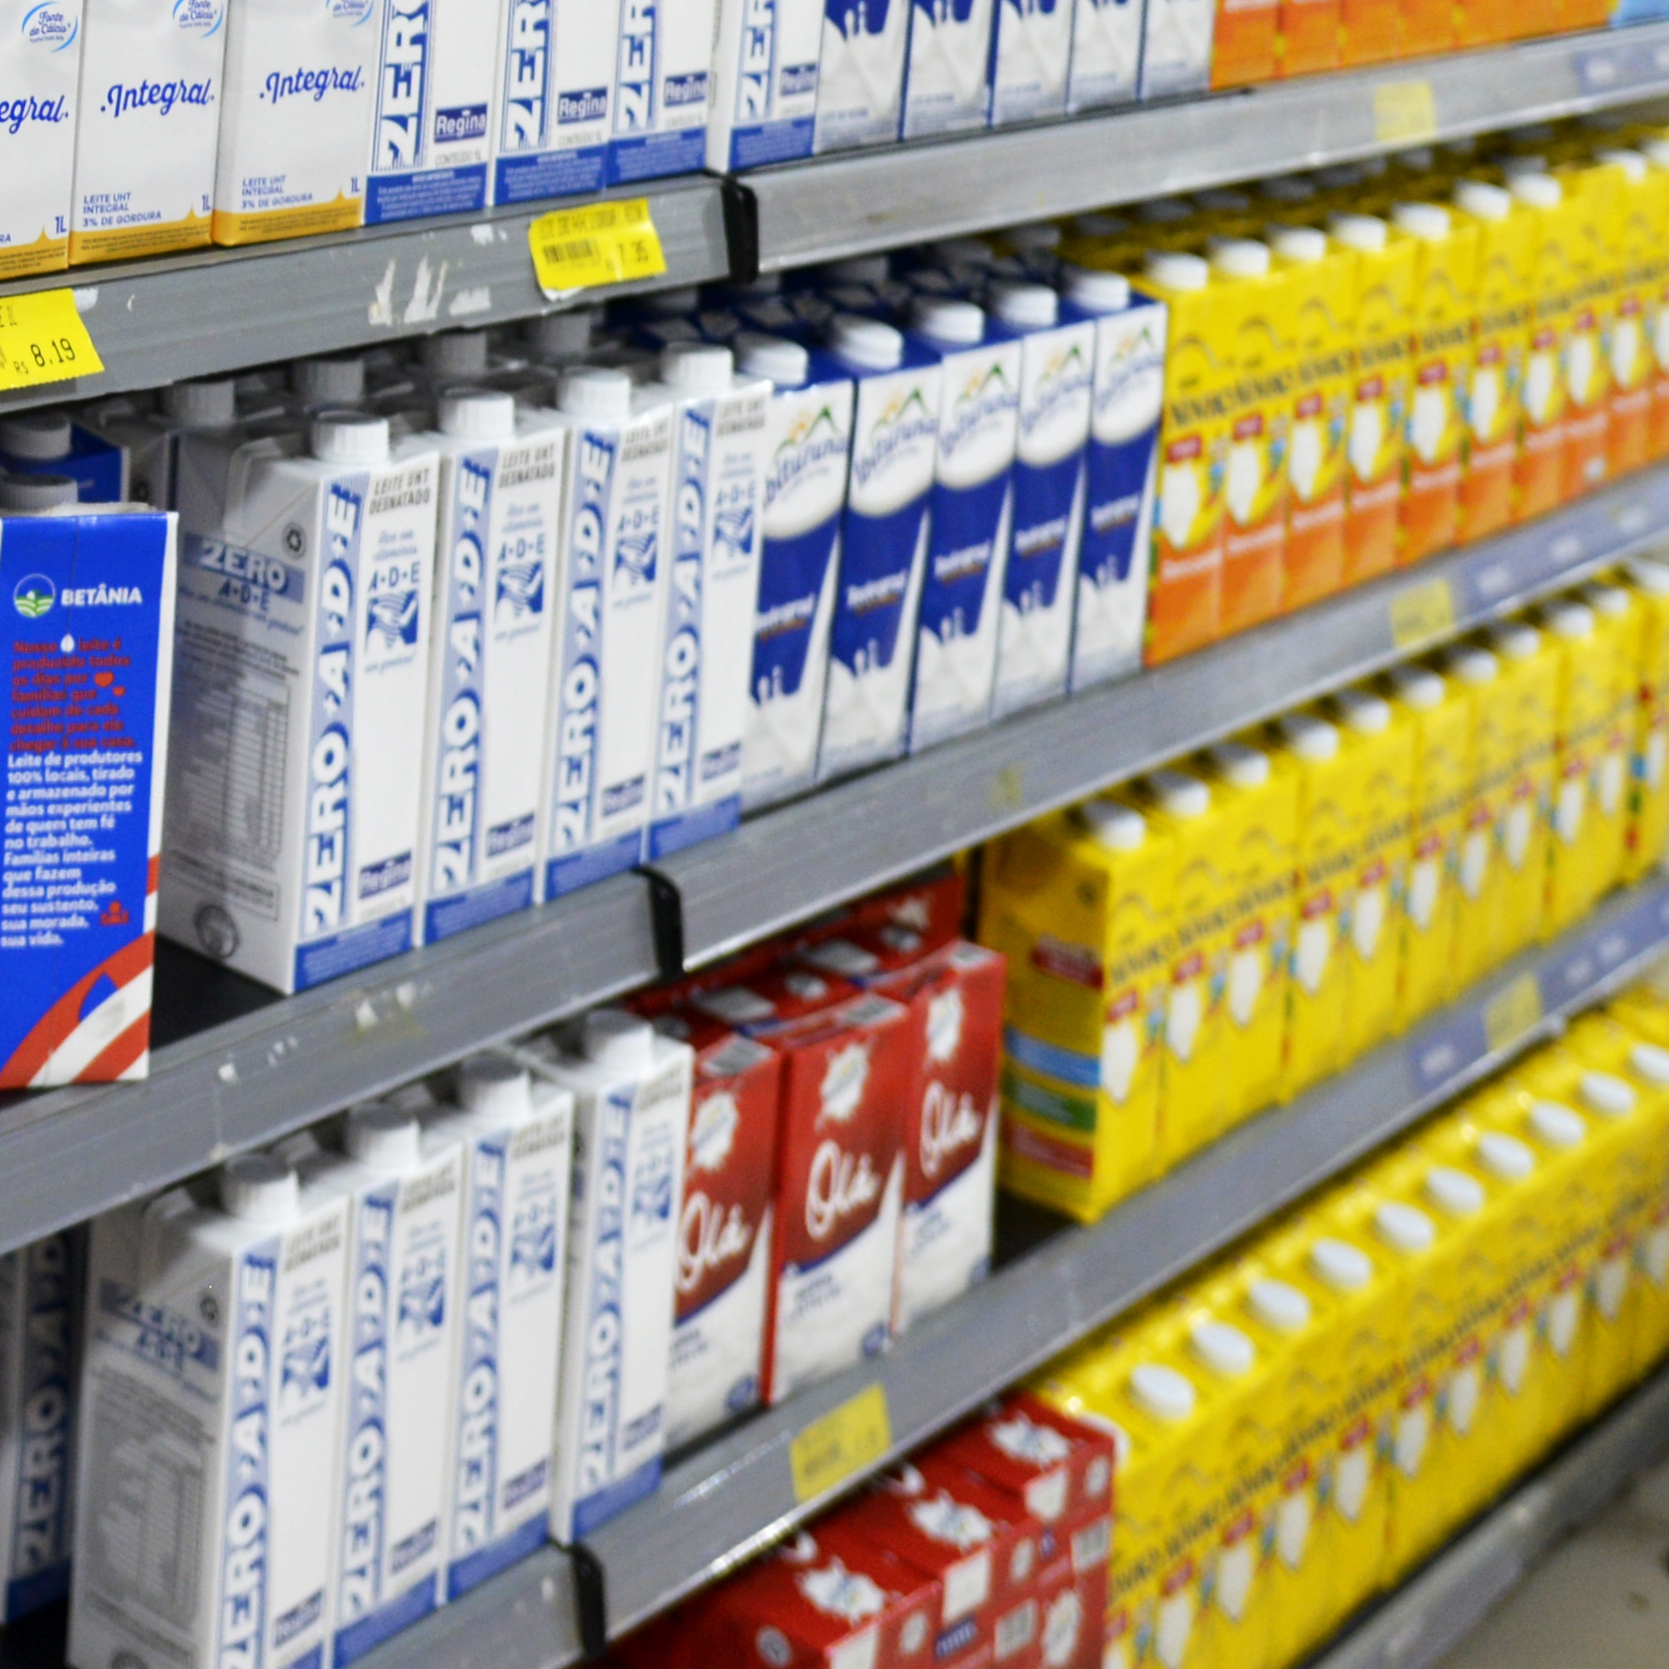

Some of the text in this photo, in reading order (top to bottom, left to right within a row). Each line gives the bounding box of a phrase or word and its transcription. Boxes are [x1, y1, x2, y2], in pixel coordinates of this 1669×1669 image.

[558, 92, 607, 120] Regina
[435, 110, 487, 138] Regina
[30, 337, 76, 370] 8.19
[200, 541, 288, 593] ZERO
[60, 583, 143, 606] BETÂNIA
[8, 750, 143, 768] Leite produtores
[18, 784, 107, 801] armazenado
[47, 798, 132, 818] experientes
[46, 880, 117, 900] produção
